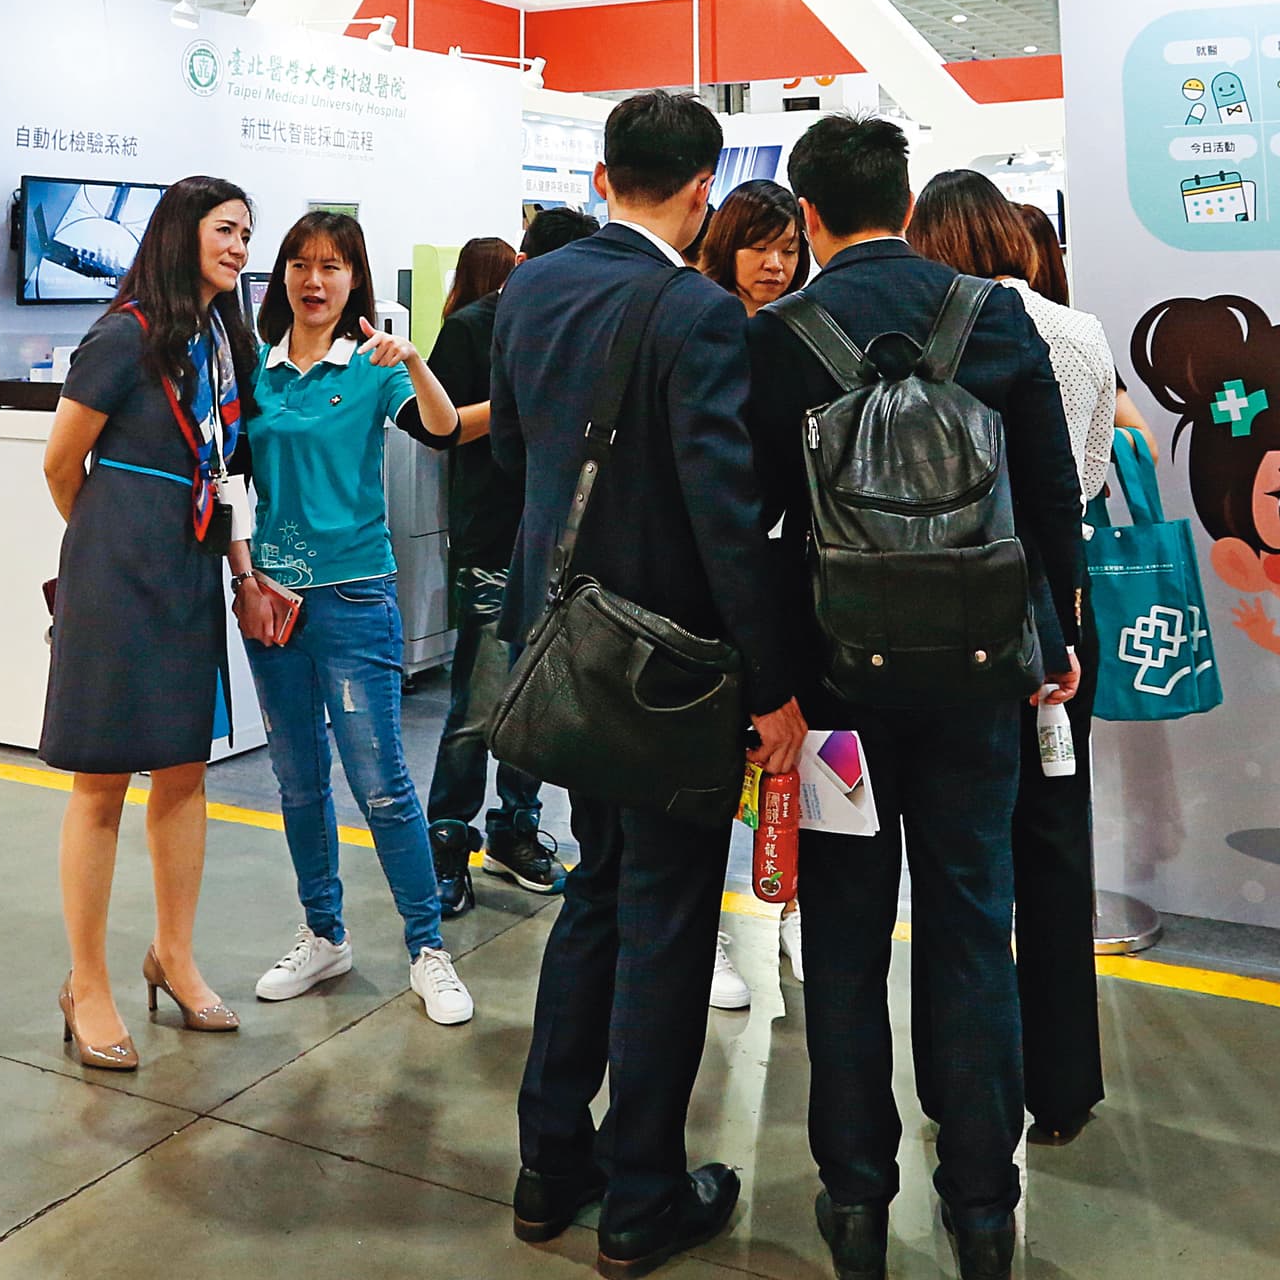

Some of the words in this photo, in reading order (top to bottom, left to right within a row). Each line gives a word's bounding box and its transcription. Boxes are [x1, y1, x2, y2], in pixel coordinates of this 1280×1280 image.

[228, 48, 407, 100] 臺北醫學大學附設醫院
[228, 81, 262, 102] Taipei
[265, 88, 309, 106] Medical
[311, 96, 364, 114] University
[366, 103, 407, 119] Hospital
[16, 125, 138, 157] 自動化檢驗系統
[240, 117, 374, 152] 新世代智能採血流程
[1190, 141, 1236, 154] 今日活動
